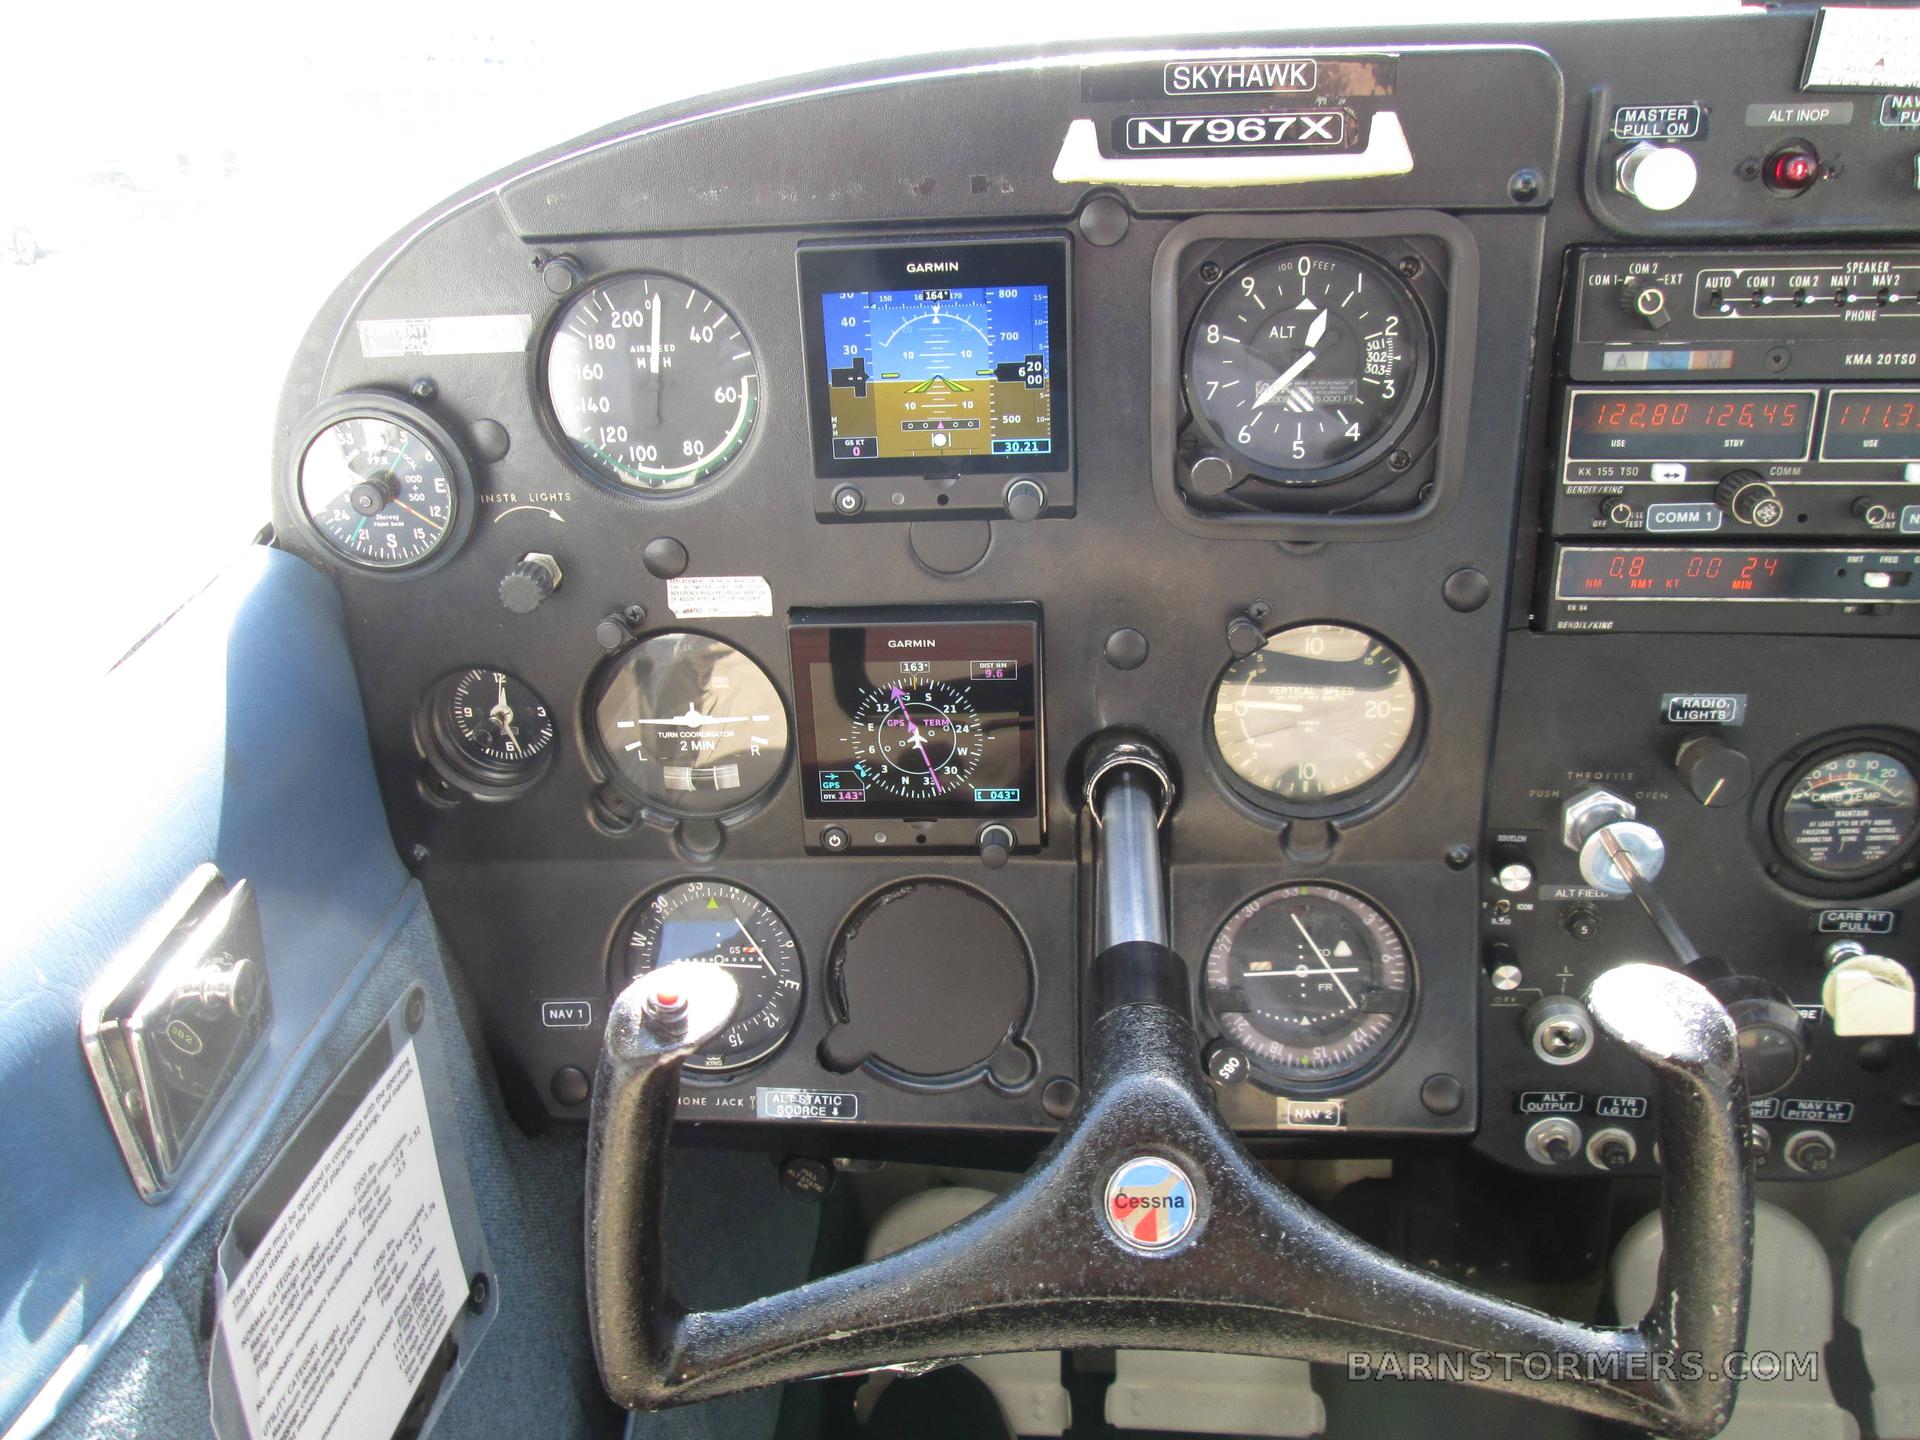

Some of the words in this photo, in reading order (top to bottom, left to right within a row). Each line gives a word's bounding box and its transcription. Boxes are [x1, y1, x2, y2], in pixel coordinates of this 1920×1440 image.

[1172, 63, 1308, 90] SKYHAWK
[1625, 109, 1688, 121] MASTER
[1768, 110, 1794, 122] ALT
[1796, 109, 1829, 121] INOP
[1137, 115, 1334, 145] N7967X
[1623, 123, 1661, 136] PULL
[1667, 123, 1688, 135] ON
[906, 262, 959, 273] GARMIN
[1297, 256, 1311, 276] 0
[1313, 262, 1336, 272] FEET
[1629, 263, 1650, 274] COM
[1652, 263, 1658, 274] 2
[1846, 263, 1889, 273] SPEAKER
[1589, 275, 1610, 286] COM
[1664, 274, 1683, 285] EXT
[1705, 277, 1731, 288] AUTO
[1747, 276, 1767, 287] COM
[1789, 276, 1810, 287] COM
[1812, 276, 1819, 287] 2
[1831, 275, 1850, 286] NAV
[1872, 275, 1891, 286] NAV
[1893, 275, 1900, 285] 2
[1242, 277, 1255, 296] 9
[998, 289, 1018, 298] 800
[611, 311, 644, 328] 200
[1845, 310, 1877, 321] PHONE
[841, 317, 856, 327] 40
[1385, 316, 1398, 336] 2
[690, 326, 713, 343] 40
[1000, 332, 1019, 341] 700
[1207, 325, 1219, 343] 8
[1269, 325, 1295, 338] ALT
[588, 335, 616, 350] 180
[843, 345, 858, 354] 30
[1366, 351, 1387, 363] 30.2
[1845, 354, 1872, 365] KMA
[1876, 354, 1891, 365] 20
[1893, 354, 1916, 365] TSO
[576, 364, 603, 380] 160
[714, 387, 737, 403] 60
[1206, 381, 1218, 400] 7
[1382, 380, 1395, 399] 3
[581, 397, 610, 413] 140
[1002, 415, 1021, 424] 500
[1598, 403, 1688, 427] 122.80
[1706, 403, 1796, 428] 126.45
[600, 426, 628, 443] 120
[1238, 423, 1251, 443] 6
[1345, 422, 1361, 441] 4
[683, 440, 704, 456] 80
[1005, 442, 1038, 451] 30.21
[1611, 439, 1626, 447] USE
[1724, 439, 1744, 448] STBY
[1863, 439, 1879, 448] USE
[630, 445, 657, 462] 100
[1292, 440, 1305, 459] 5
[1578, 467, 1593, 477] KX
[1597, 467, 1614, 476] 155
[1620, 466, 1639, 477] TSO
[1770, 466, 1801, 476] COMM
[1566, 485, 1624, 495] BENDIX/KING
[481, 494, 517, 503] INSTR
[529, 493, 571, 502] LIGHTS
[1655, 511, 1699, 524] COMM
[1706, 511, 1712, 523] 1
[1625, 519, 1643, 528] TEST
[1609, 556, 1646, 579] 0.8
[1687, 557, 1721, 578] 00
[1741, 557, 1779, 578] 24
[1731, 580, 1753, 590] MIN
[1557, 621, 1613, 630] BENDIX/KING
[888, 640, 936, 648] GARMIN
[1305, 637, 1324, 655] 10
[985, 669, 1003, 678] 9.6
[1268, 687, 1316, 696] VERTICAL
[1322, 687, 1354, 696] SPEED
[1365, 700, 1391, 719] 20
[1682, 699, 1726, 709] RADIO
[1676, 710, 1726, 720] LIGHTS
[887, 719, 905, 727] GPS
[679, 731, 734, 739] COORDINATOR
[680, 741, 688, 751] 2
[691, 740, 715, 750] MIN
[1298, 763, 1316, 780] 10
[1567, 771, 1635, 781] THROTTLE
[822, 781, 840, 789] GPS
[1529, 790, 1560, 799] PUSH
[1635, 791, 1669, 800] OPEN
[1851, 792, 1881, 802] TEMP
[1555, 889, 1576, 898] ALT
[1828, 913, 1863, 922] CARB
[1866, 912, 1886, 921] HT
[1839, 922, 1872, 931] PULL
[550, 1010, 573, 1019] NAV
[1219, 1057, 1240, 1079] OBS
[715, 1097, 744, 1107] JACK
[772, 1095, 795, 1104] ALT
[799, 1095, 842, 1105] STATIC
[1543, 1093, 1565, 1102] ALT
[1612, 1098, 1635, 1107] LTR
[776, 1105, 827, 1116] SOURCE
[1527, 1102, 1576, 1111] OUTPUT
[1603, 1107, 1619, 1115] LG
[1622, 1107, 1637, 1115] LT
[1798, 1101, 1824, 1111] NAV
[1827, 1102, 1841, 1111] LT
[1295, 1109, 1321, 1119] NAV
[1325, 1110, 1332, 1119] 2
[1787, 1110, 1827, 1120] PITOT
[1831, 1111, 1846, 1121] HT
[231, 1284, 246, 1309] This
[245, 1244, 273, 1289] airplane
[271, 1221, 288, 1249] must
[296, 1168, 325, 1214] operated
[330, 1116, 363, 1167] compliance
[362, 1099, 376, 1123] with
[384, 1054, 410, 1095] operating
[1114, 1191, 1184, 1210] Cessna
[267, 1236, 288, 1272] stated
[306, 1188, 322, 1215] form
[266, 1251, 301, 1308] CATEGORY
